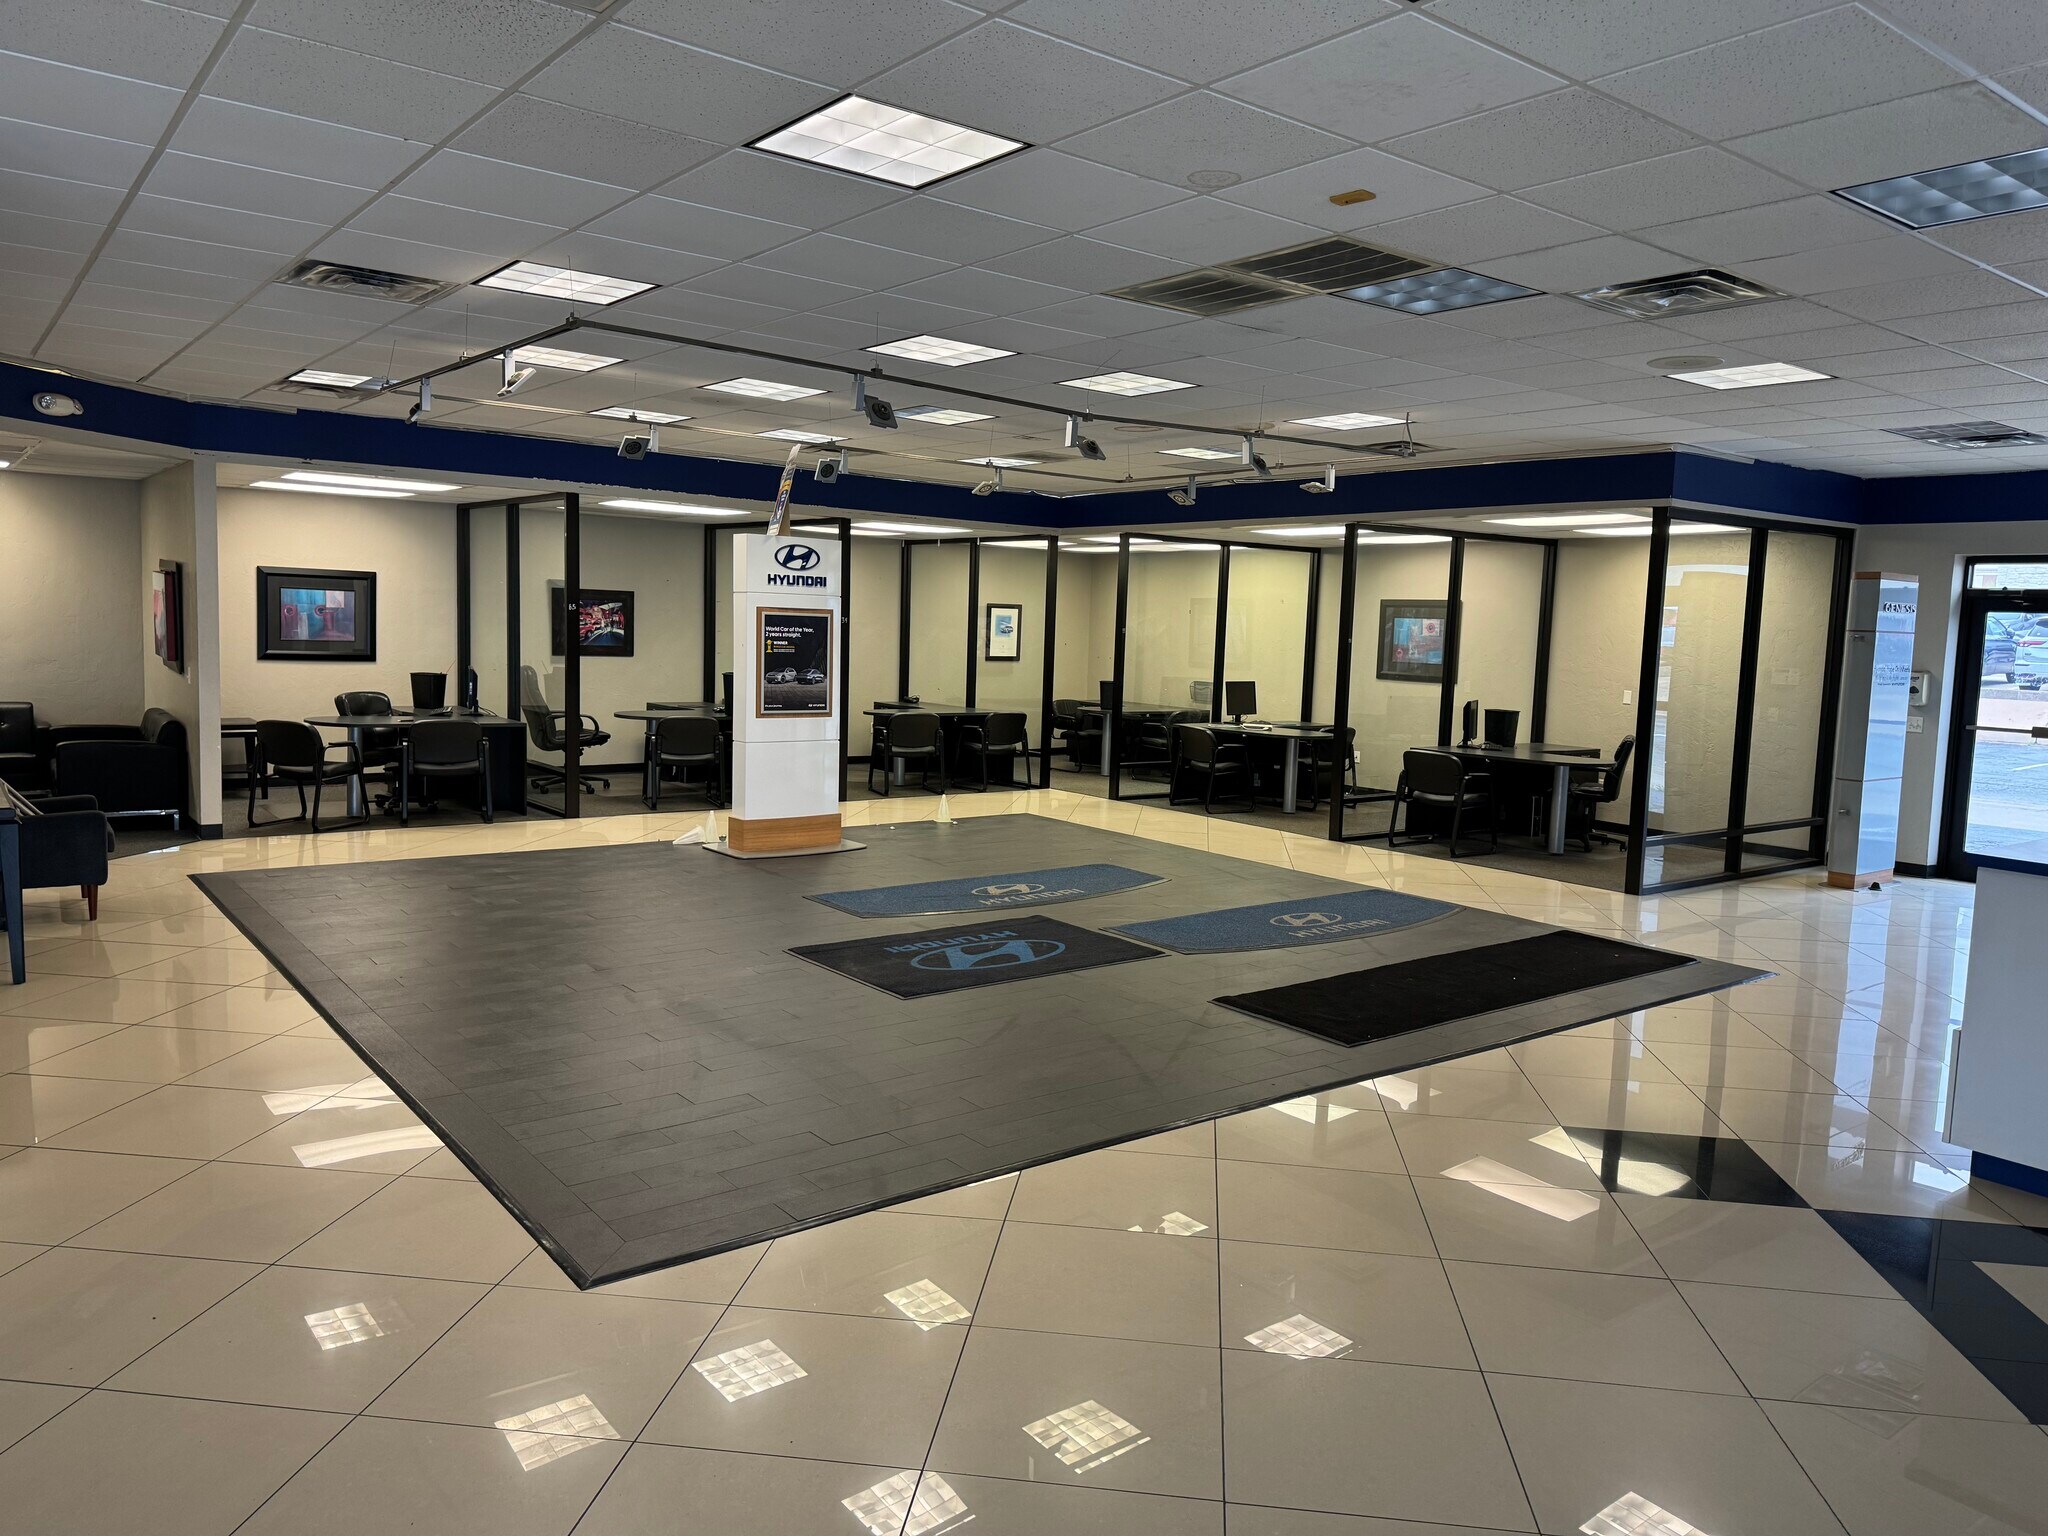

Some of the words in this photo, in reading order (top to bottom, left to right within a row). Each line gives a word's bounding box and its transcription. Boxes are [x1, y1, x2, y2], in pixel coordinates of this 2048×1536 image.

[768, 574, 827, 587] HYUNDAI
[1883, 602, 1917, 613] GENESIS
[978, 888, 1085, 906] HYUNDAI
[1288, 918, 1391, 938] HYUNDAI
[884, 930, 1019, 953] HYUNDAI
